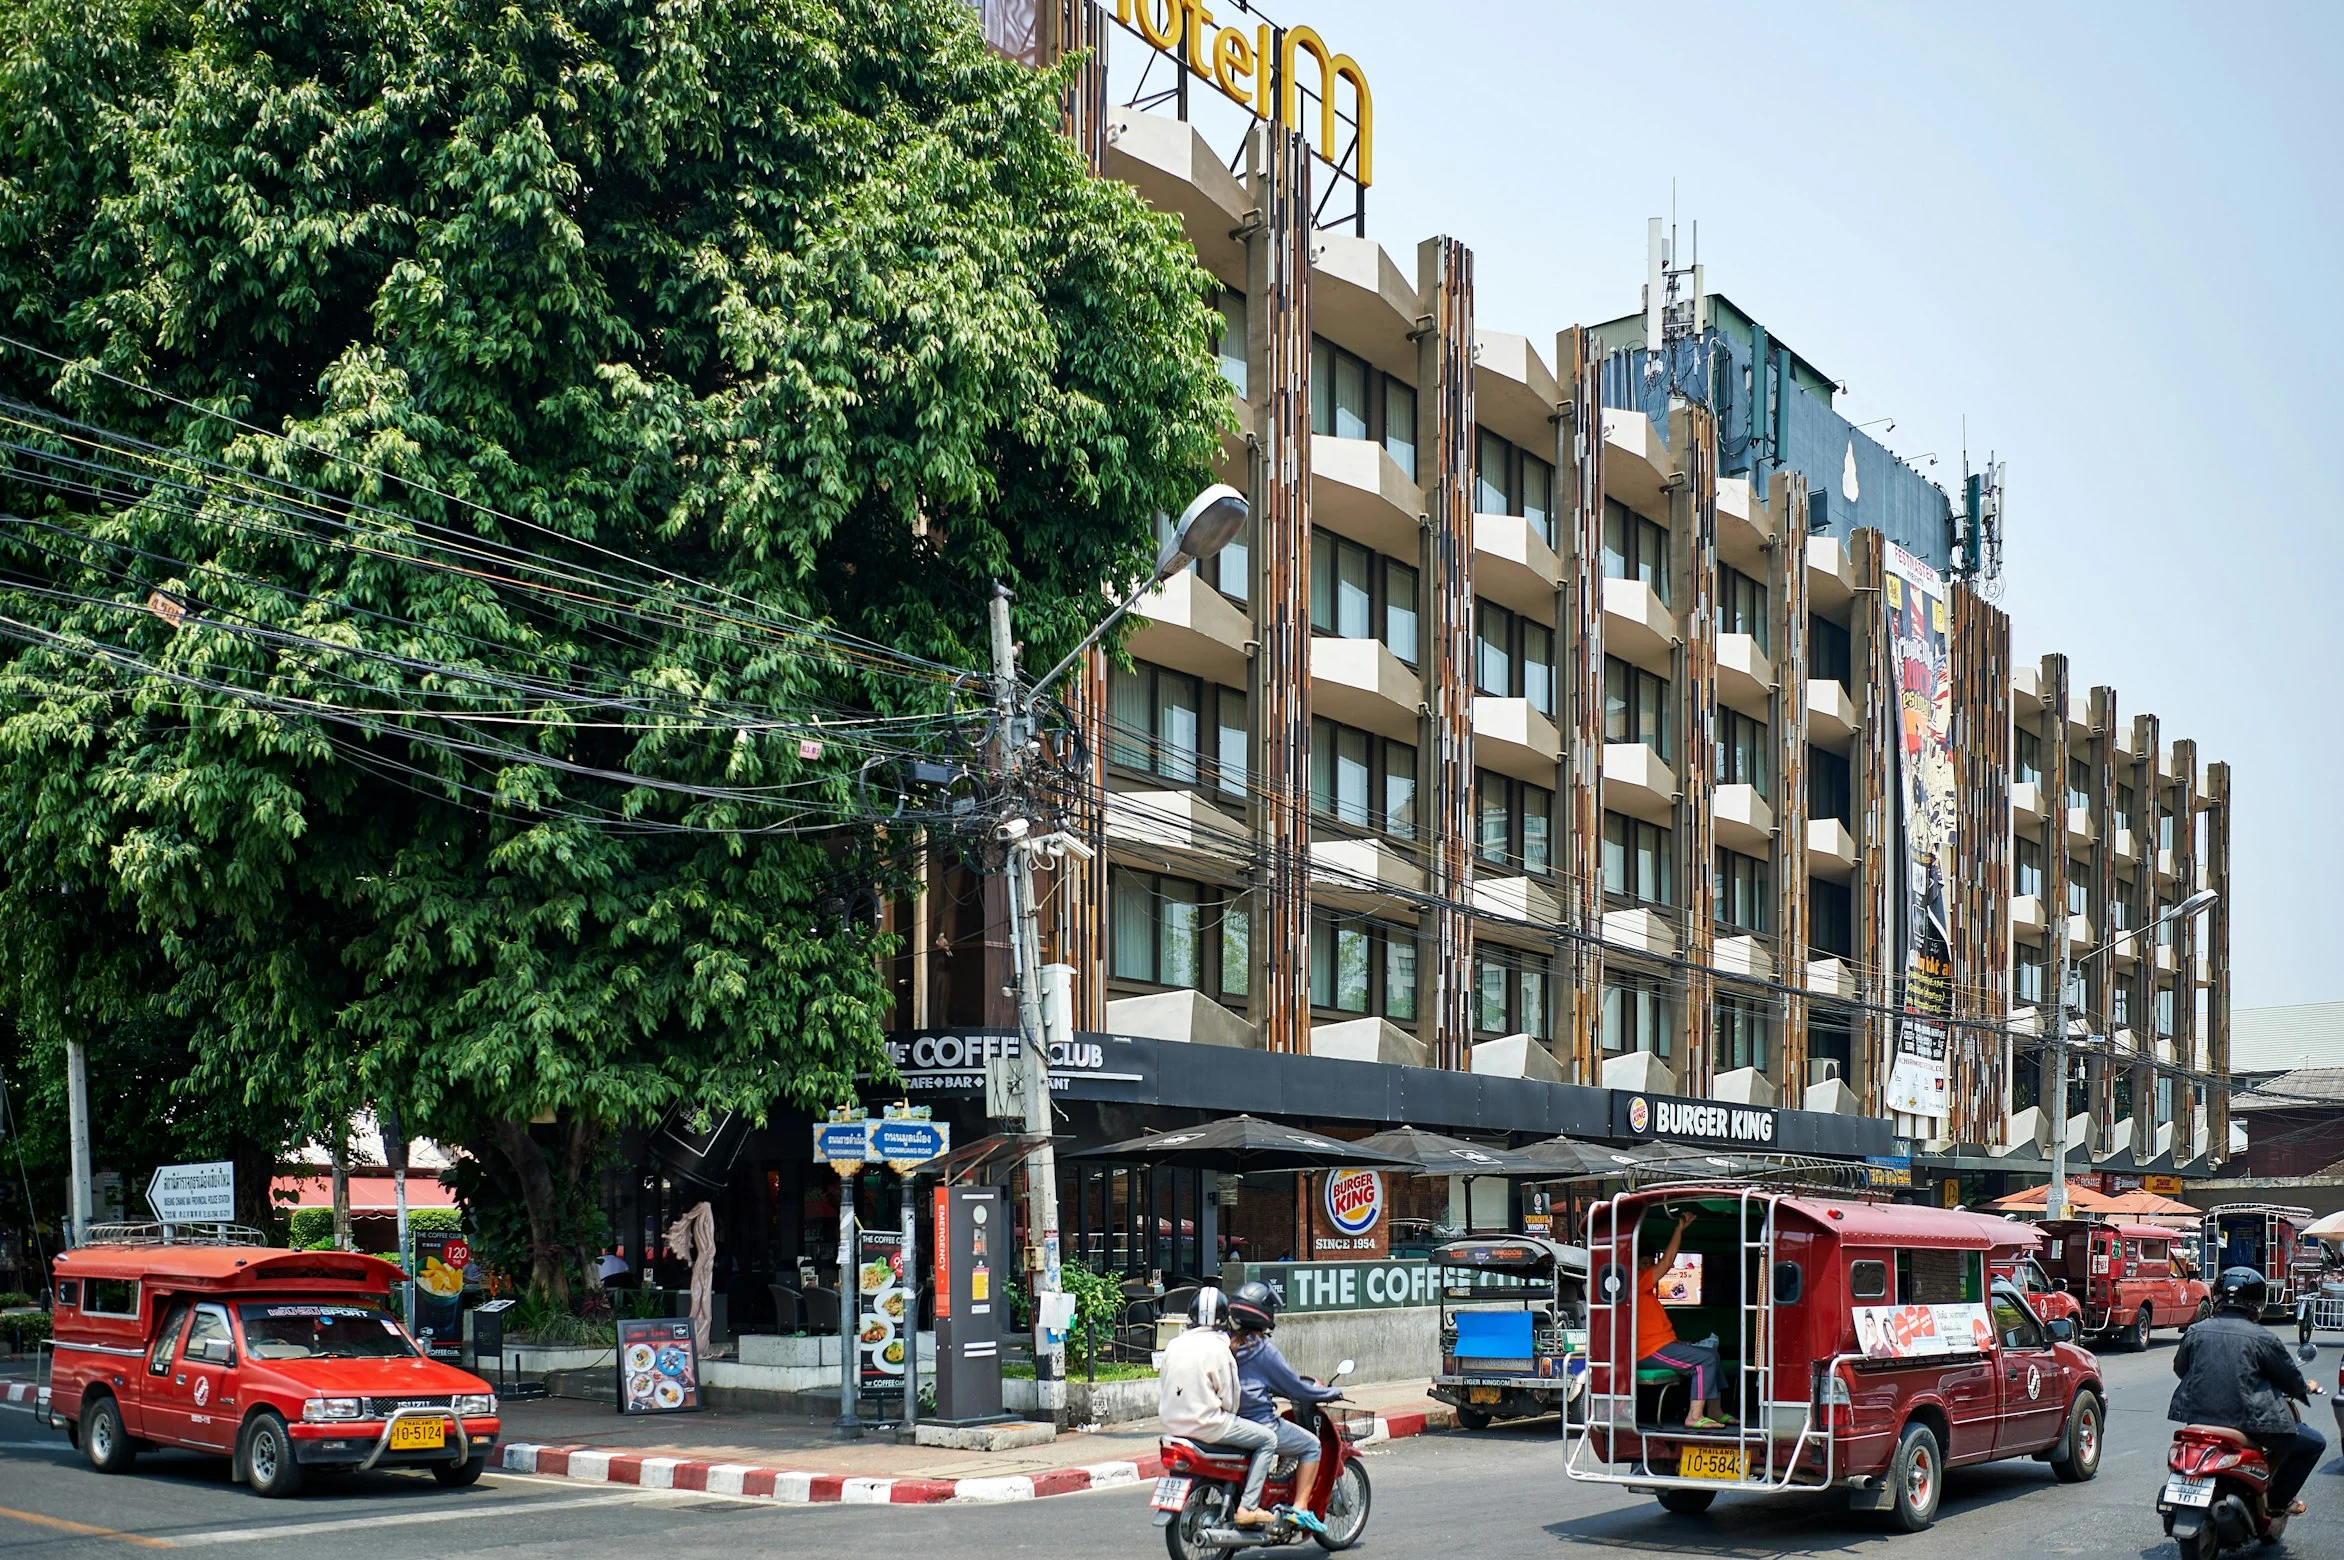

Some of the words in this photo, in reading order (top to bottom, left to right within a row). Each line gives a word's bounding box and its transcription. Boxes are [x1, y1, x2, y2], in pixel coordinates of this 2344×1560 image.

[1117, 0, 1270, 120] otel
[1894, 546, 1934, 583] FESTMASTER
[1048, 1043, 1104, 1068] CLUB
[945, 1077, 972, 1089] BAR
[1656, 1101, 1728, 1138] BURGER
[1731, 1109, 1773, 1142] KING
[1334, 1173, 1373, 1198] BURGER
[1335, 1186, 1375, 1216] KING
[863, 1235, 873, 1243] THE
[874, 1236, 895, 1244] COFFEE
[938, 1204, 946, 1271] EMERGENCY
[1315, 1238, 1350, 1250] SINCE
[1353, 1238, 1376, 1250] 1954
[448, 1247, 467, 1259] 120
[1449, 1251, 1468, 1259] TIGER
[1294, 1269, 1355, 1306] THE
[1366, 1265, 1471, 1303] COFFEE
[320, 1308, 369, 1318] SPORT
[873, 1379, 895, 1387] COFFEE
[396, 1426, 441, 1440] 10-5124
[1698, 1448, 1735, 1456] THAILAND
[2178, 1493, 2198, 1504] 101
